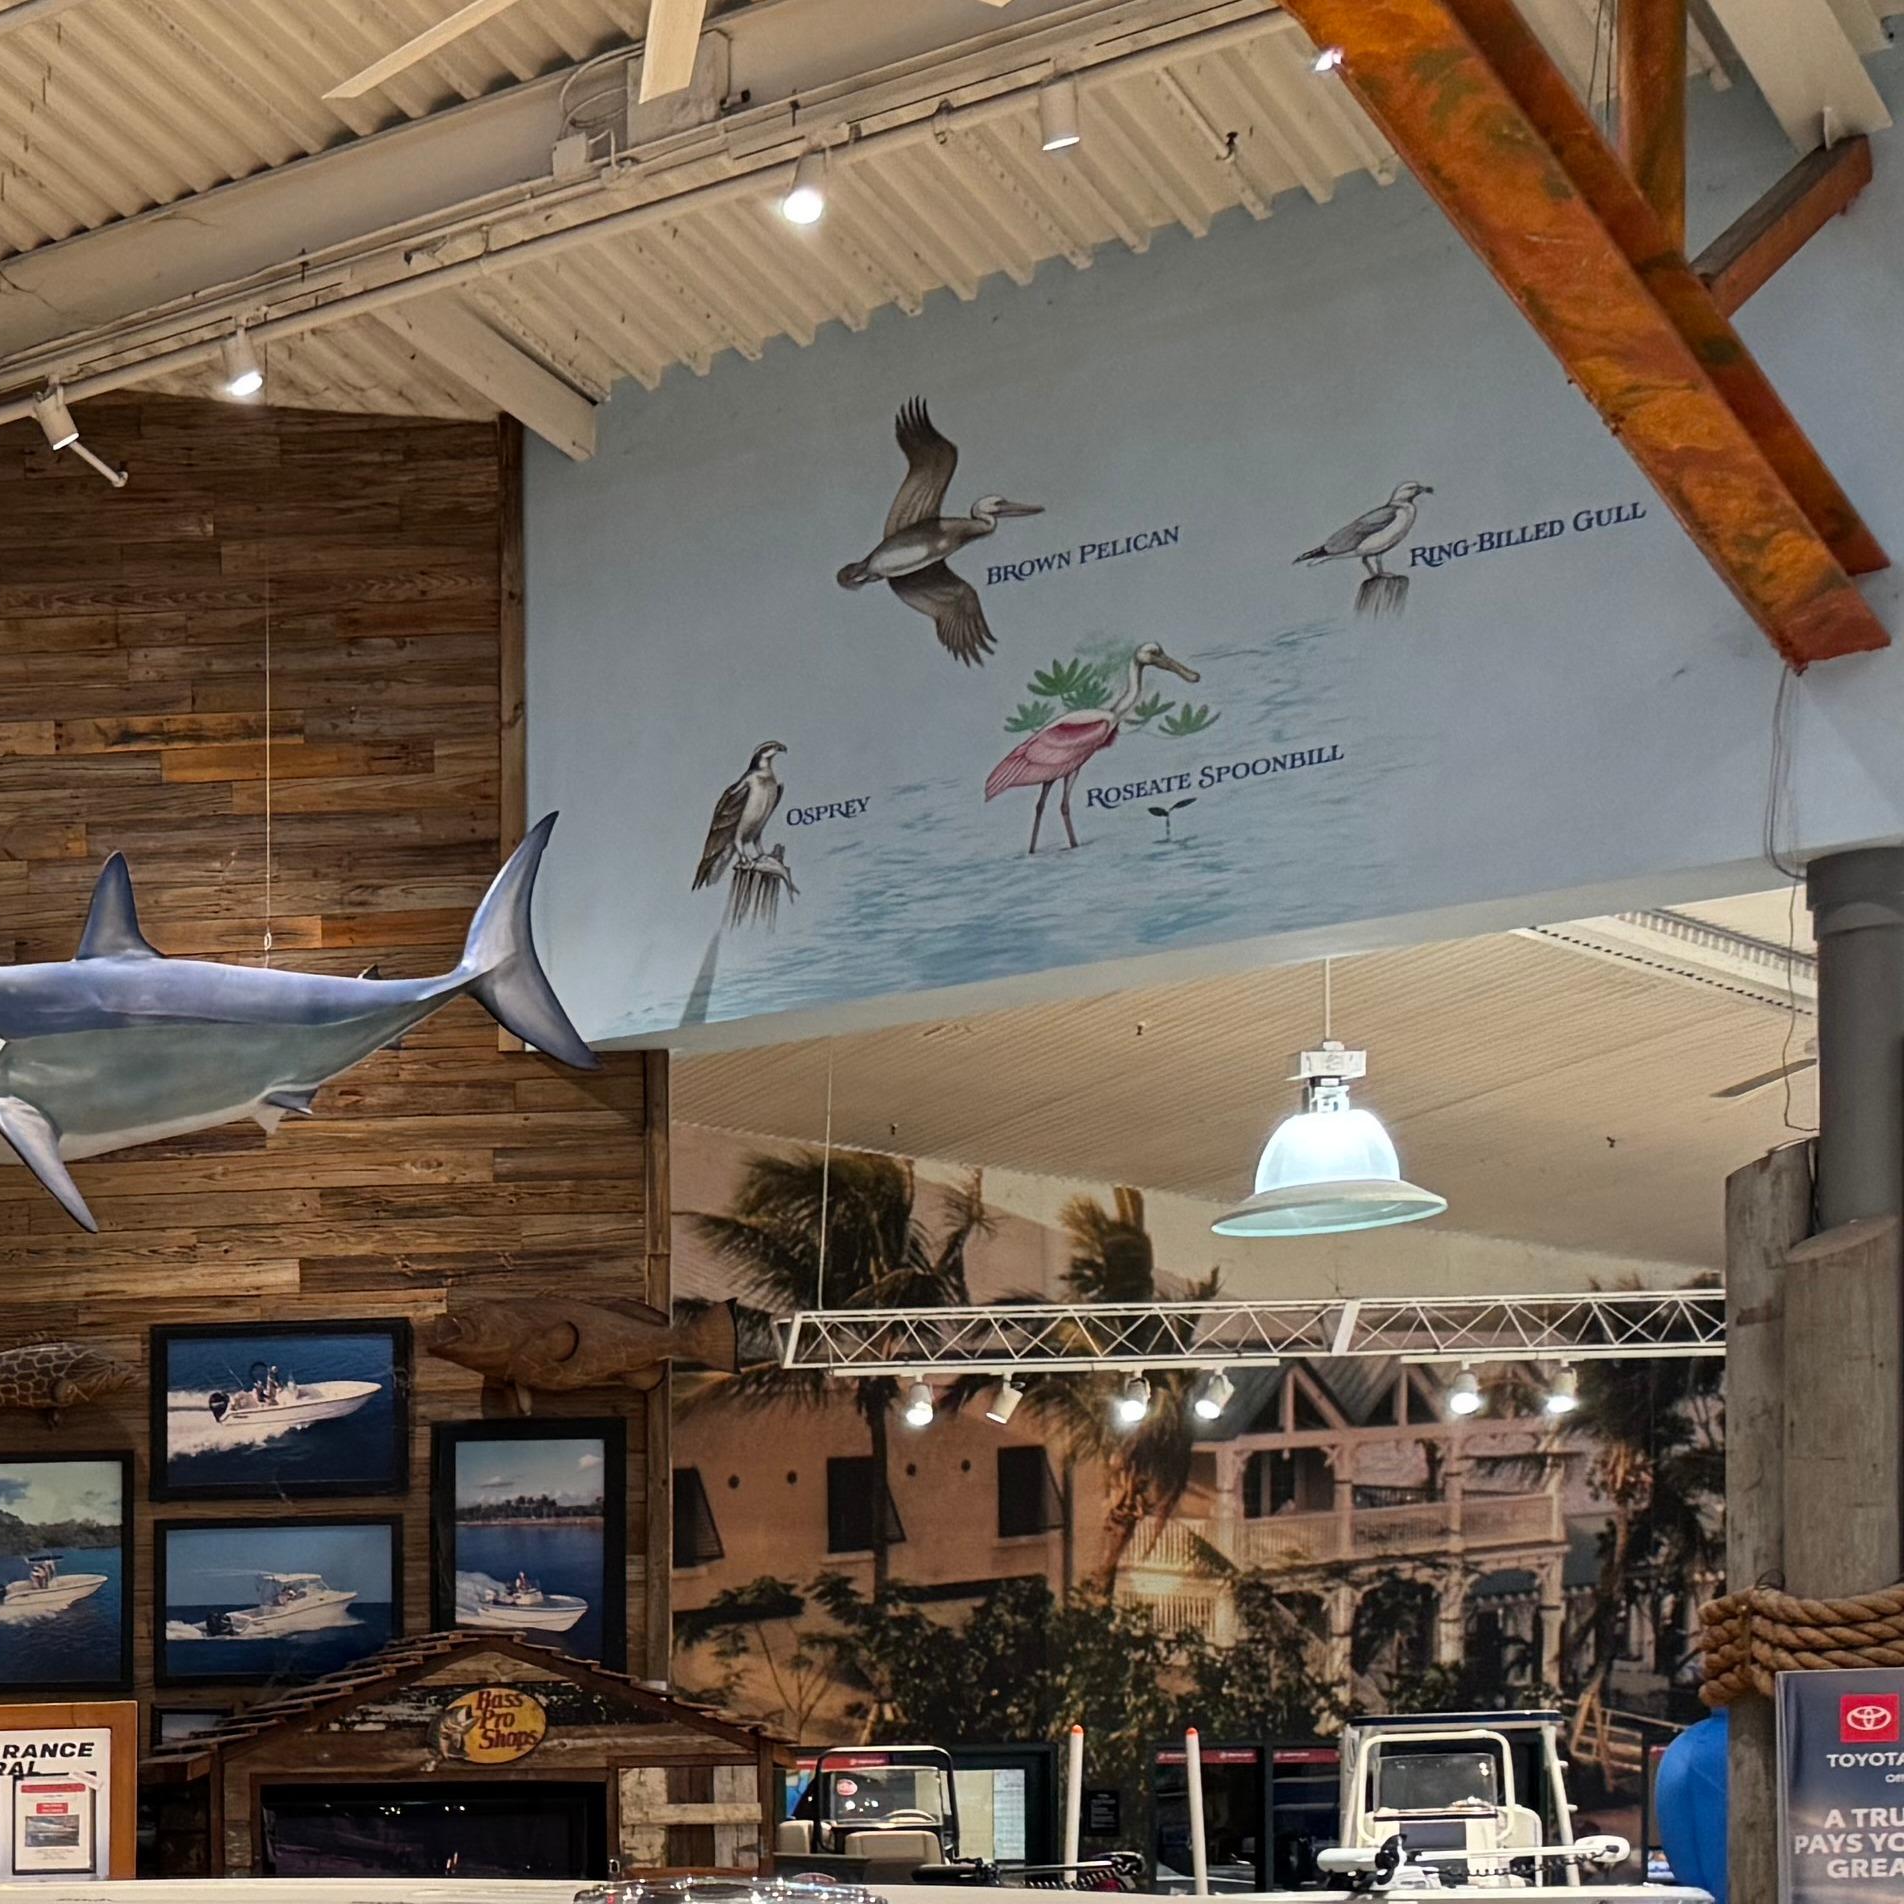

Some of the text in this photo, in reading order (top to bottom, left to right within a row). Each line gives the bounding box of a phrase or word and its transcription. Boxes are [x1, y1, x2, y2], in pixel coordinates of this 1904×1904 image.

[1409, 502, 1646, 568] RING-BILLED GULL
[986, 525, 1180, 586] BROWN PELICAN
[1086, 743, 1345, 809] ROSEATE SPOONBILL
[786, 796, 871, 826] OSPREY
[475, 1690, 523, 1711] Bass
[479, 1707, 515, 1729] Pro
[479, 1729, 538, 1751] Shops
[1824, 1809, 1846, 1829] A
[1794, 1833, 1864, 1855] PAYS
